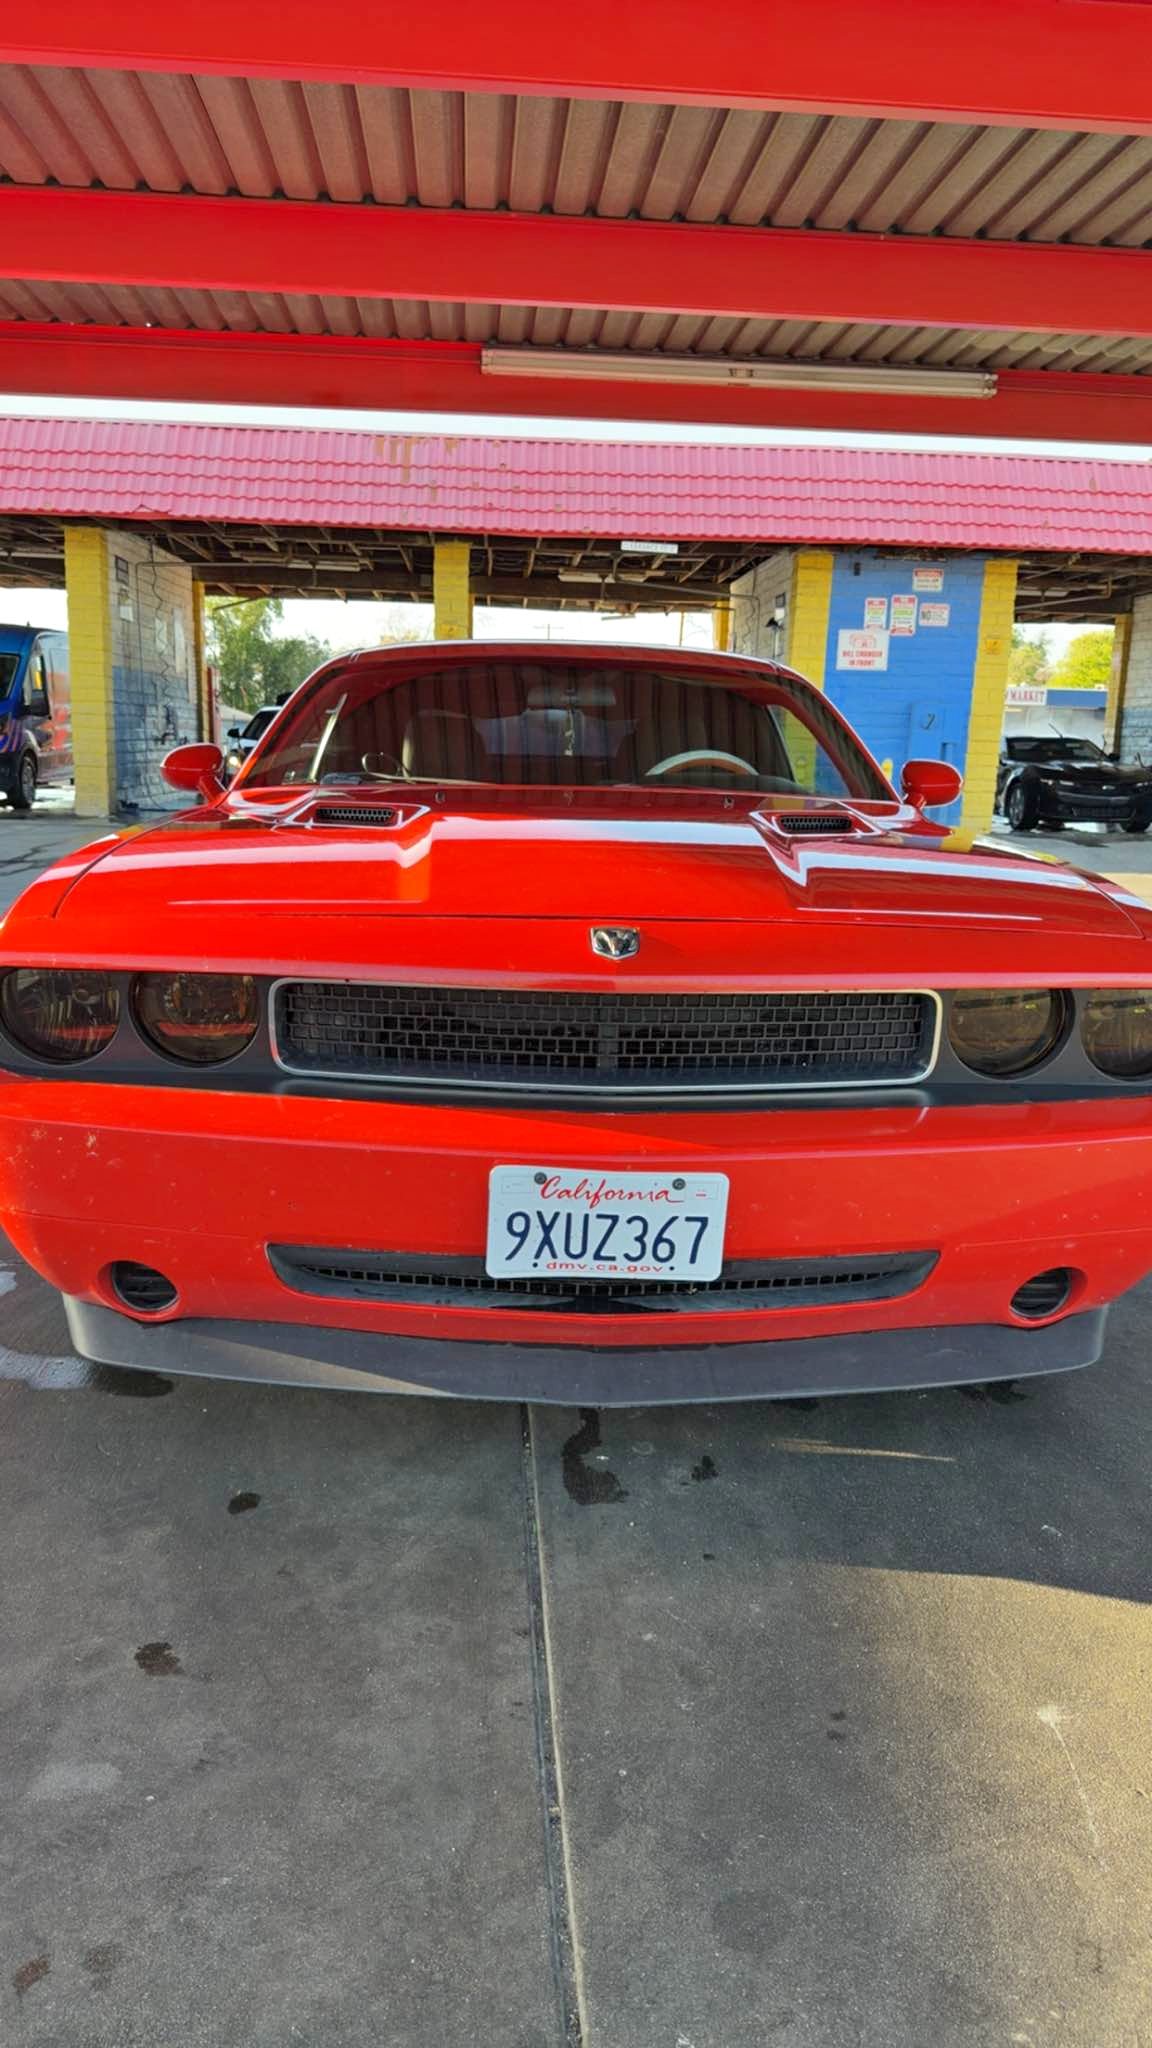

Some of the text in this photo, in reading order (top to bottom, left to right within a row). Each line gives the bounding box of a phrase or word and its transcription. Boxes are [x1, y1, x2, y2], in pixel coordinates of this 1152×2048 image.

[1010, 690, 1045, 702] MARKET
[540, 1176, 684, 1209] California
[505, 1210, 709, 1264] 9XUZ367
[546, 1262, 663, 1273] dmv.ca.gov
